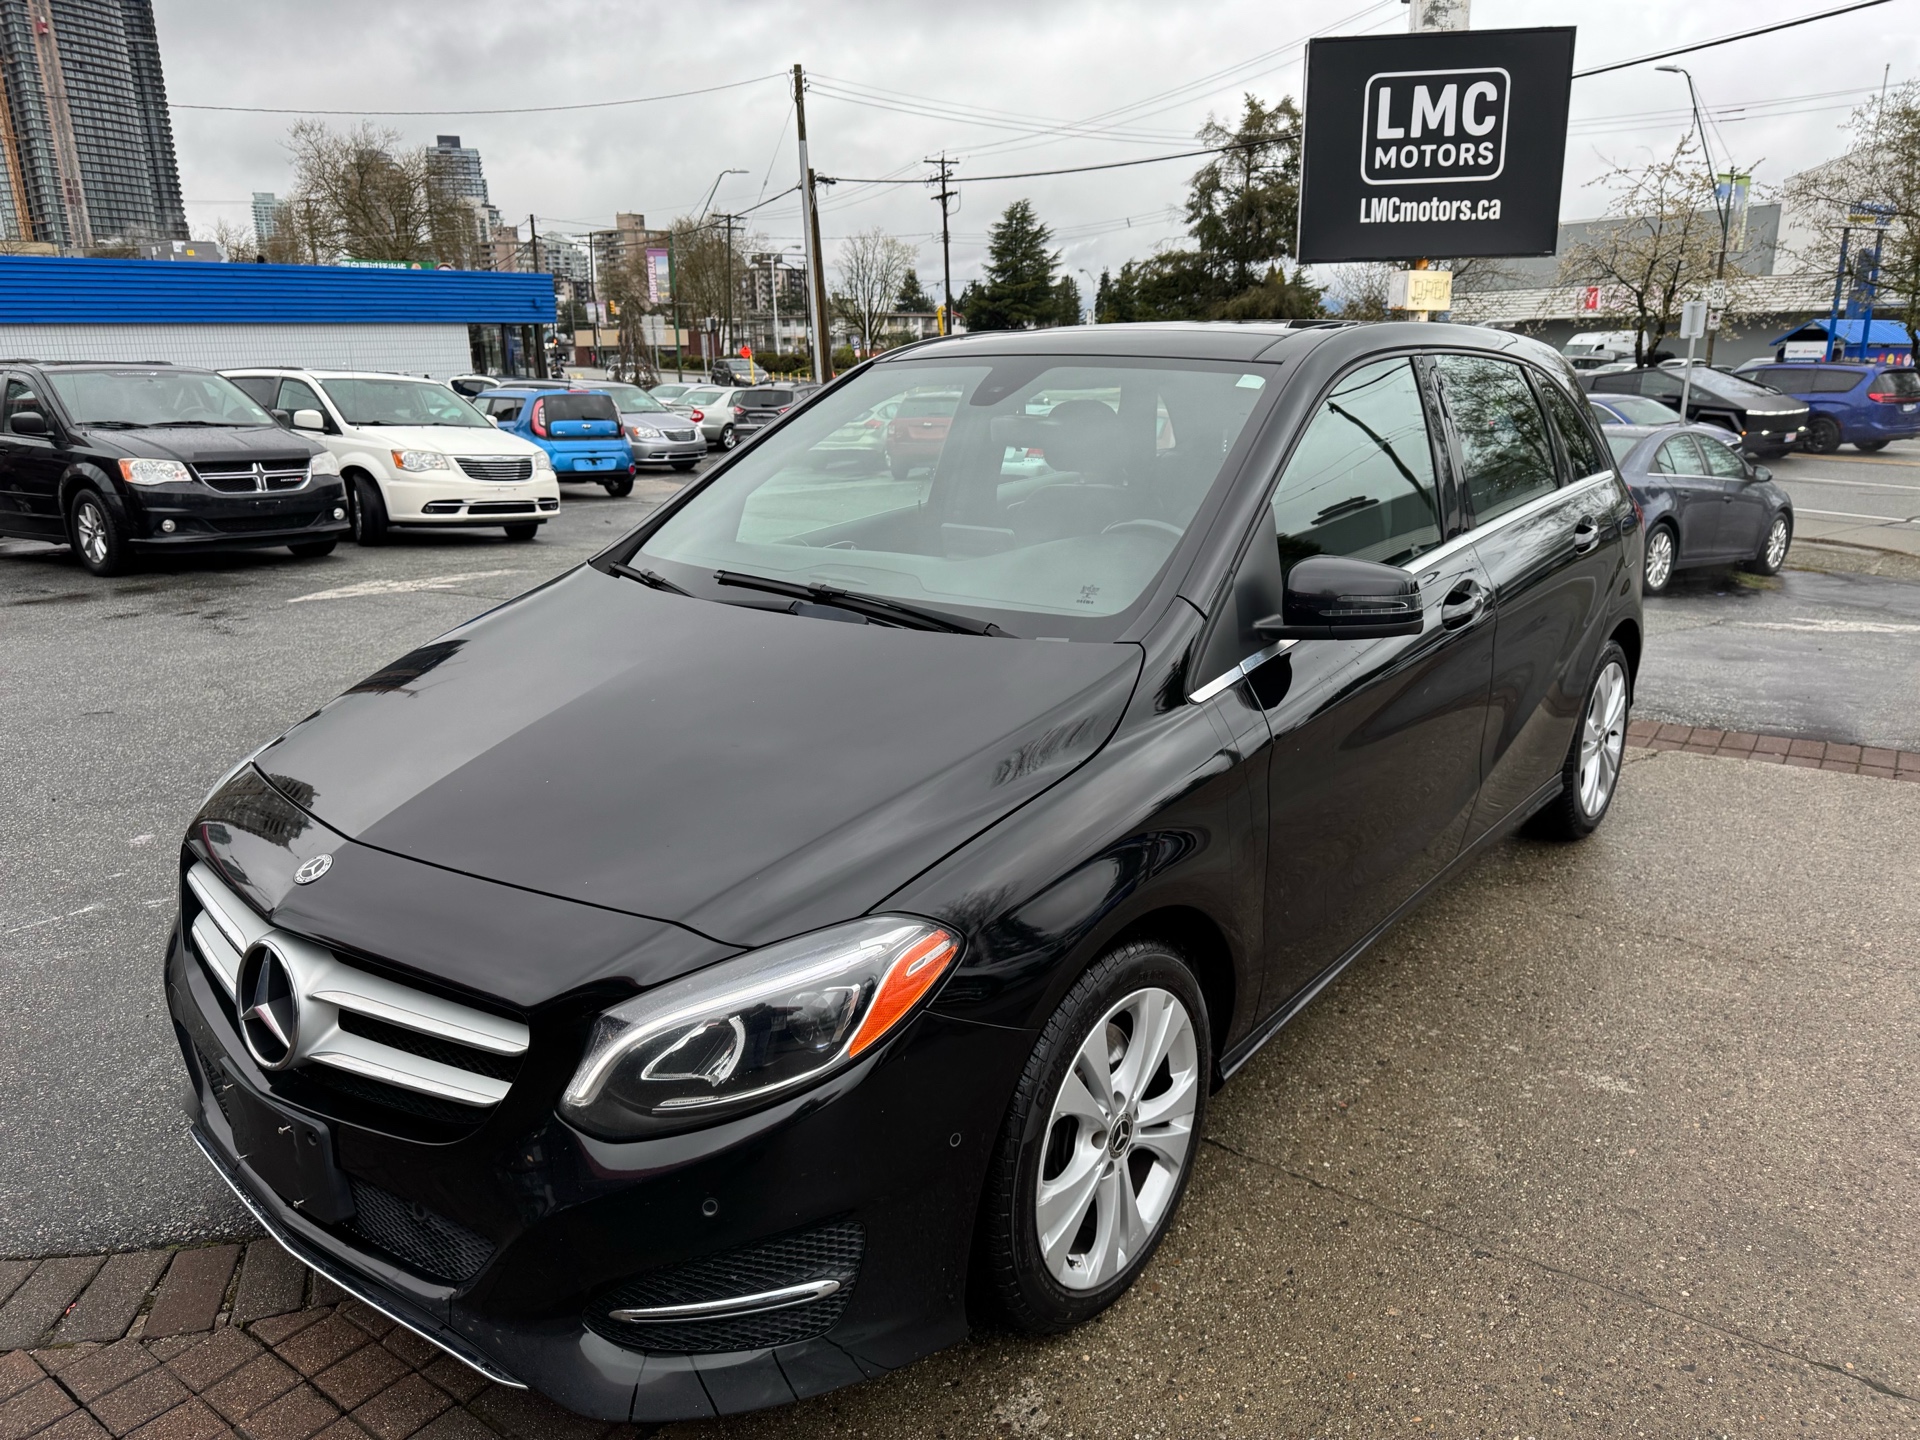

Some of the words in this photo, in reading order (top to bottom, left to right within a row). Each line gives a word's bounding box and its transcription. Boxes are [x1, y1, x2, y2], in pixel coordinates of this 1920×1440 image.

[1376, 81, 1498, 140] LMC
[1374, 142, 1494, 170] MOTORS
[1359, 196, 1502, 224] LMCmotors.ca
[1713, 287, 1724, 300] 50
